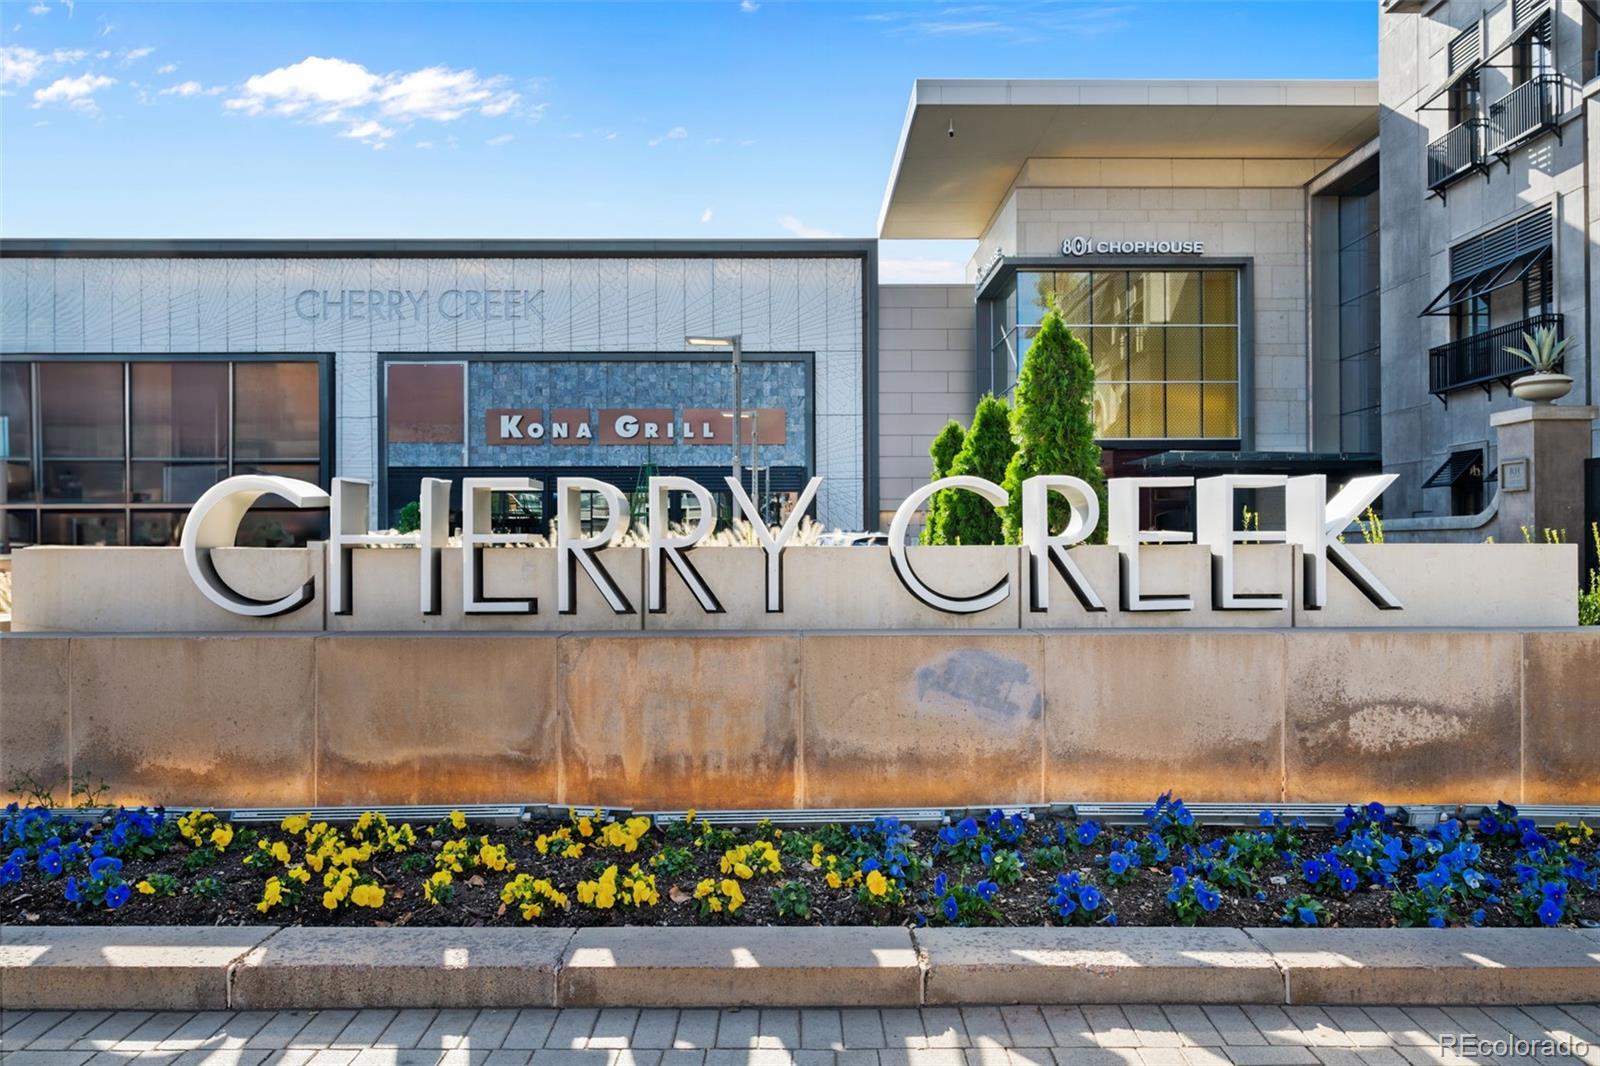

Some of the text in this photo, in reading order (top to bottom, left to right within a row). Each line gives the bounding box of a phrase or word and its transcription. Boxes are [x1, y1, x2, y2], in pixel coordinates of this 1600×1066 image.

[1062, 236, 1204, 256] 801 CHOPHOUSE
[294, 289, 546, 321] CHERRY CREEK
[500, 414, 715, 439] KONA GRILL
[180, 473, 1403, 617] CHERRY CREEK
